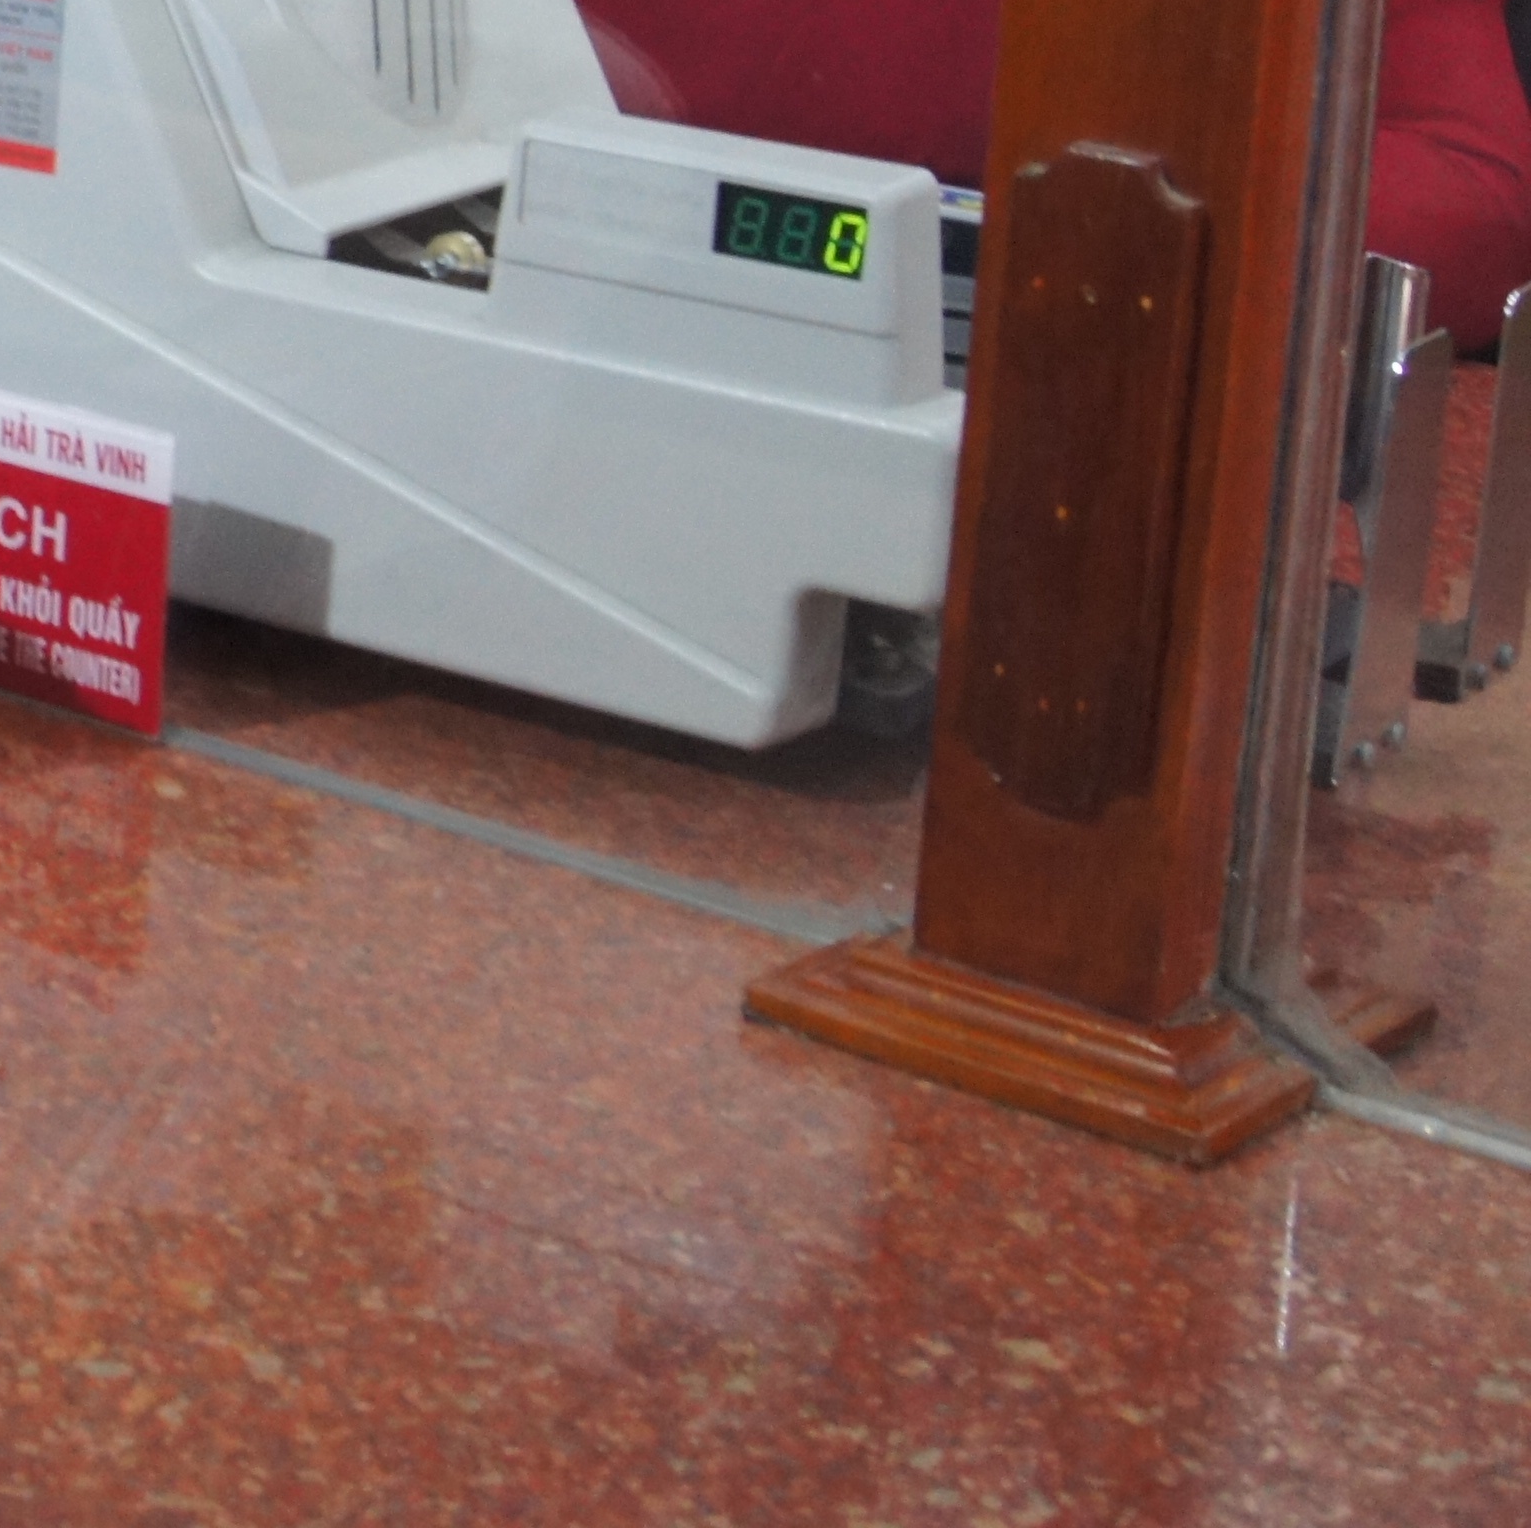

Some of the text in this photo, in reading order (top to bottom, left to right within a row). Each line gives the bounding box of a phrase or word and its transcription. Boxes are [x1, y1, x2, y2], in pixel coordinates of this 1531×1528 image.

[1, 411, 36, 456] HẢI
[46, 427, 86, 469] TRÀ
[95, 442, 147, 484] VINH
[13, 629, 47, 673] THE
